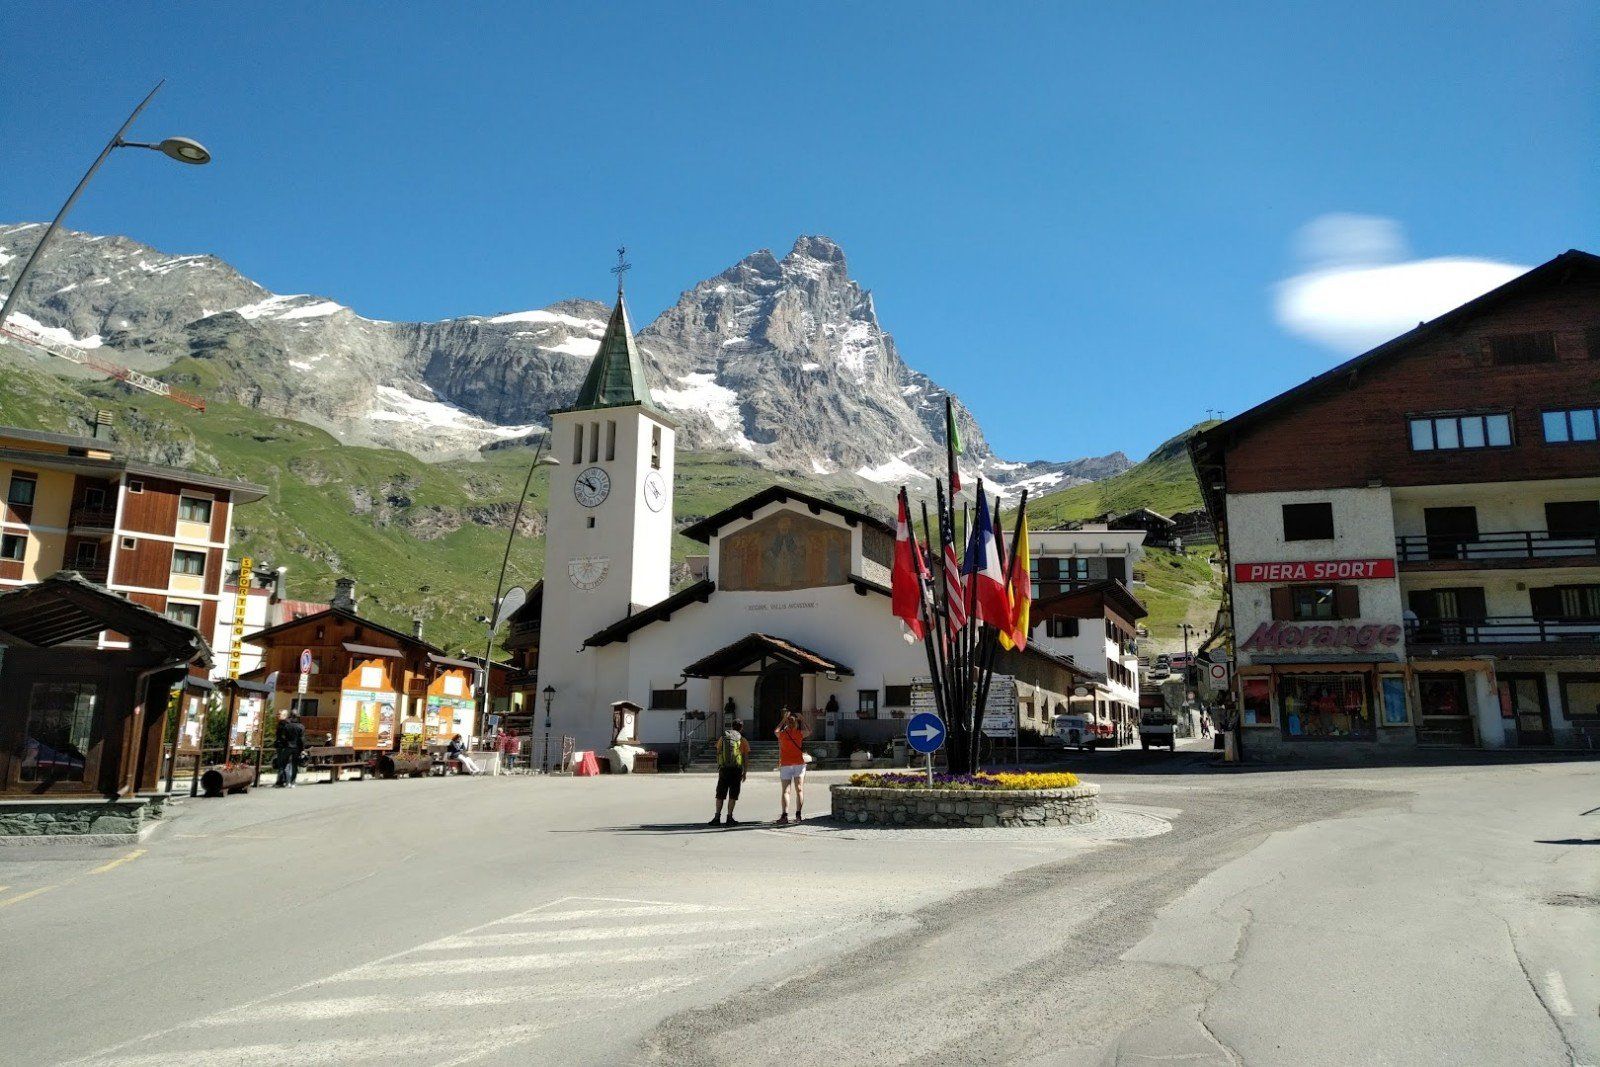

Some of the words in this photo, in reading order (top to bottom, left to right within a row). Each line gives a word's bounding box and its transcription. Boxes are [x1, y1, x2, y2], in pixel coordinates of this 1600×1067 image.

[1251, 564, 1306, 579] PIERA
[1313, 562, 1377, 577] SPORT
[234, 558, 250, 635] SPORTING
[1240, 621, 1401, 651] Morange
